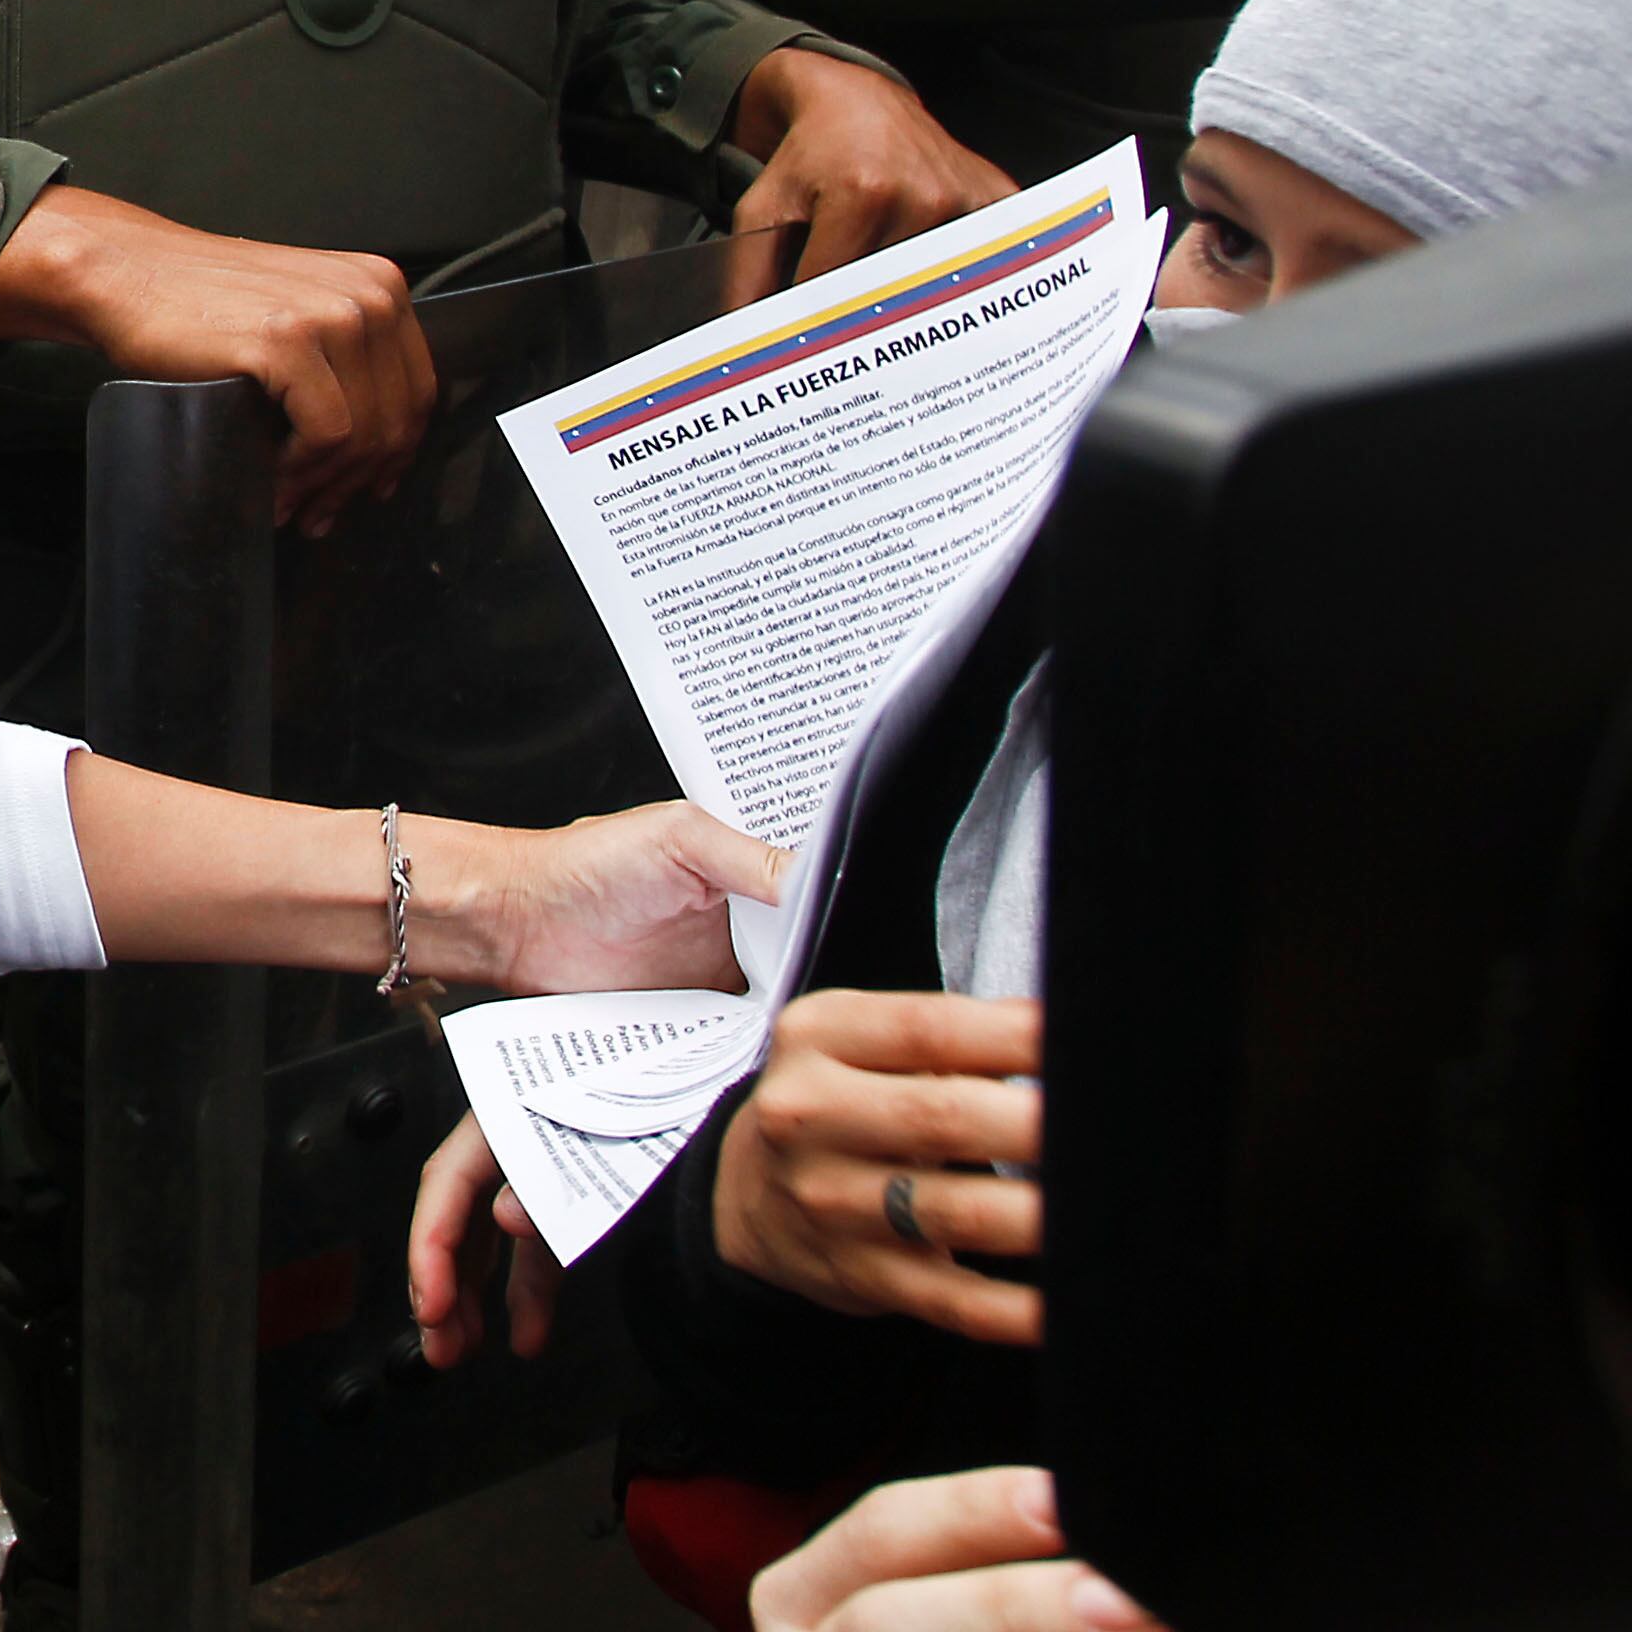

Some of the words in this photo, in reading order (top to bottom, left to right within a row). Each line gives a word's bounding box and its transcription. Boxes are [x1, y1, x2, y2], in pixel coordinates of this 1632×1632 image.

[607, 413, 718, 470] MENSAJE
[721, 405, 740, 427] A
[739, 392, 775, 418] LA
[775, 355, 870, 404] FUERZA
[873, 311, 978, 367] ARMADA
[979, 257, 1092, 323] NACIONAL
[593, 466, 682, 505] Conciudadanos
[684, 447, 732, 470] oficiales
[733, 443, 740, 455] y
[743, 423, 799, 448] soldados,
[799, 406, 840, 426] familia
[842, 390, 883, 411] militar.
